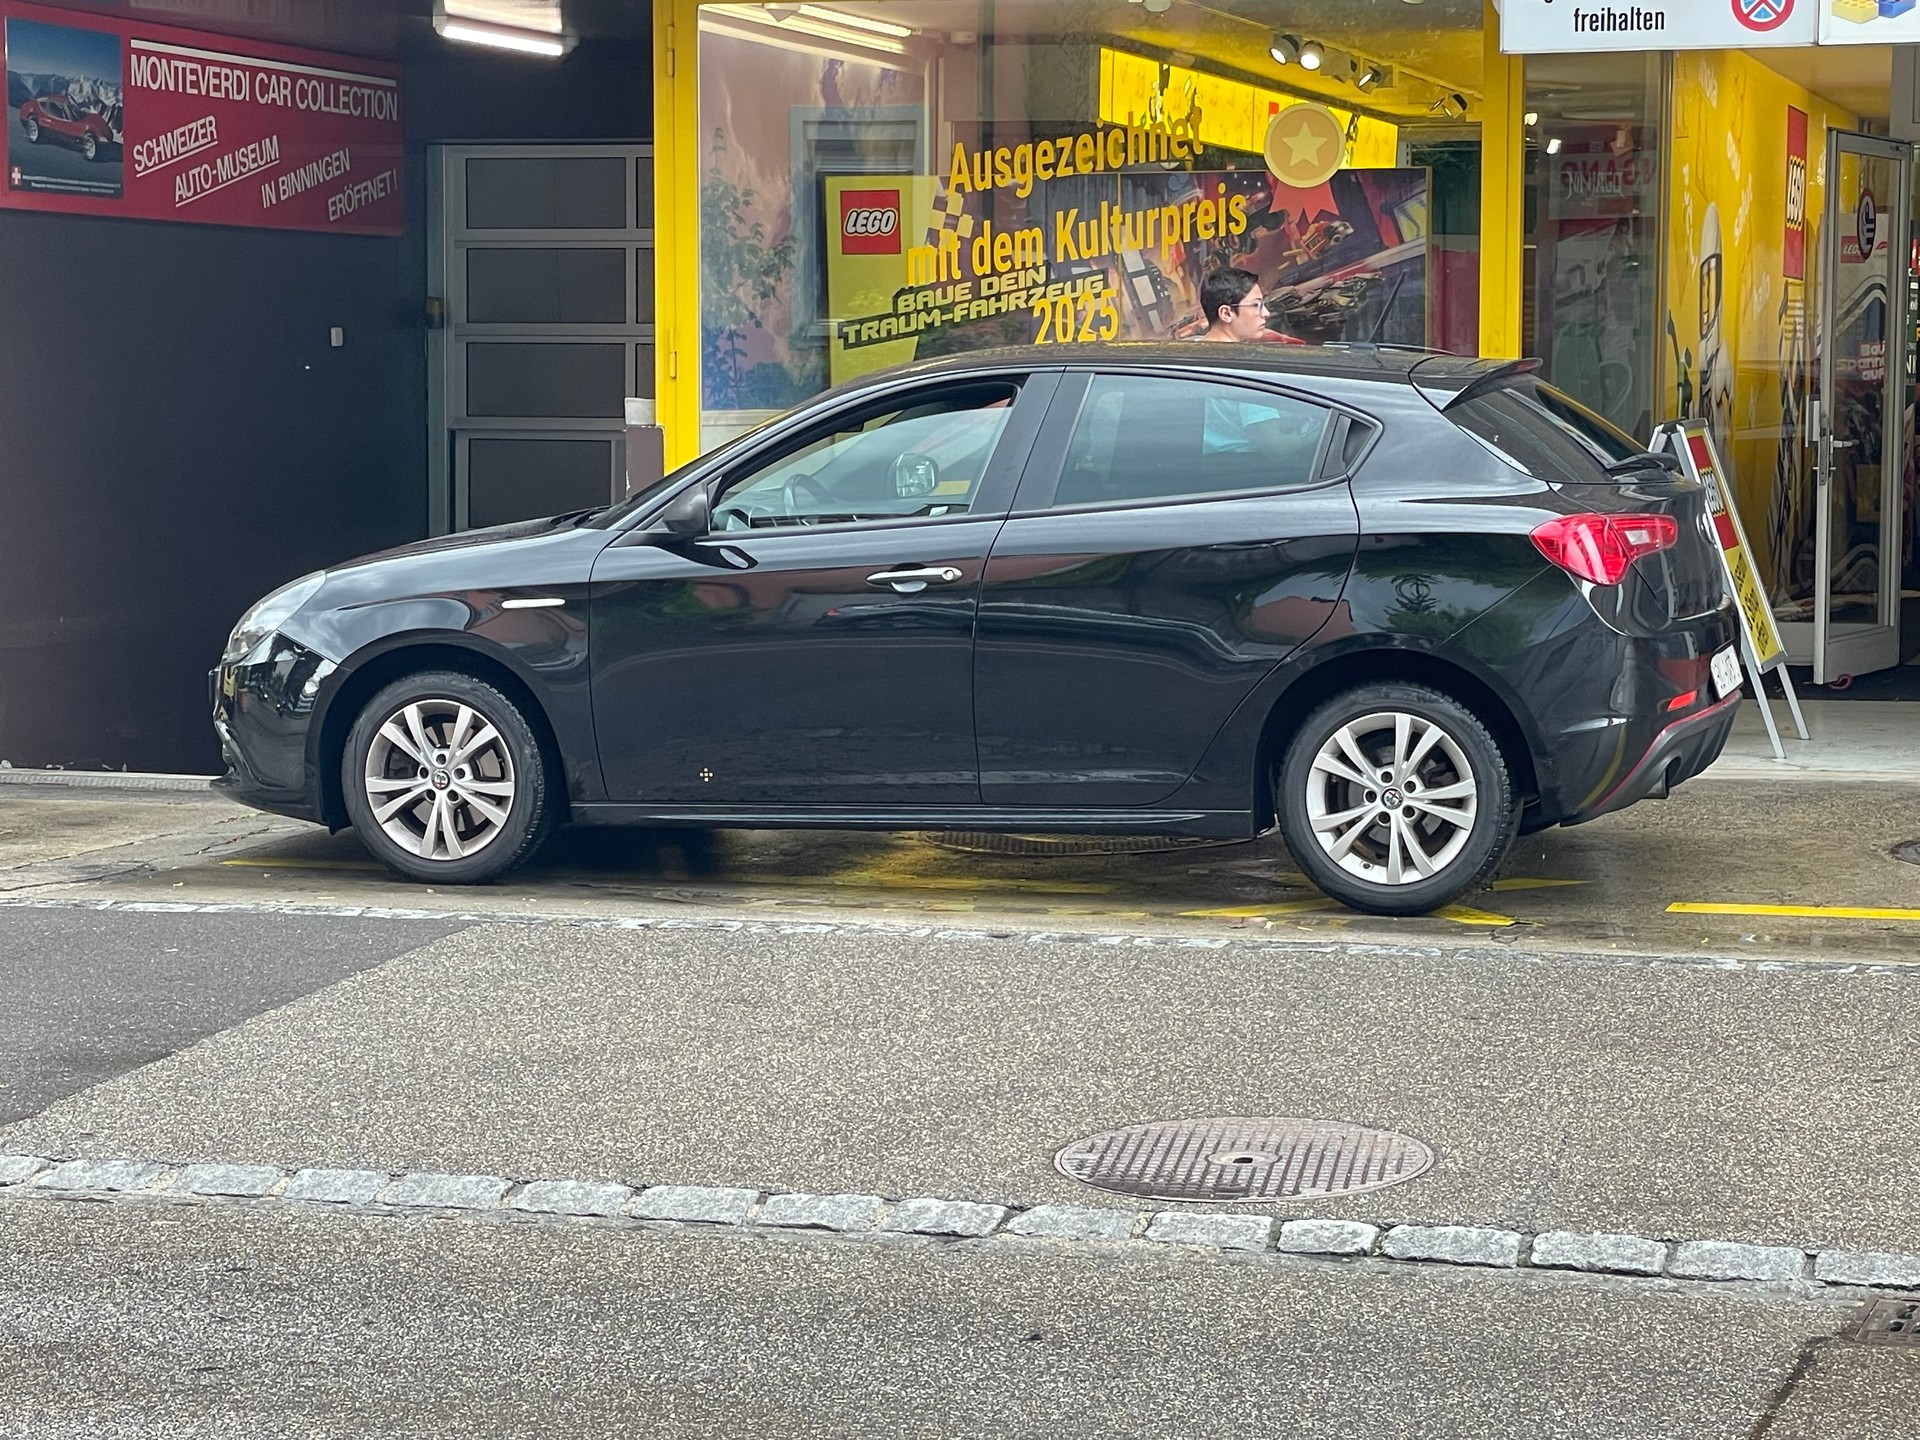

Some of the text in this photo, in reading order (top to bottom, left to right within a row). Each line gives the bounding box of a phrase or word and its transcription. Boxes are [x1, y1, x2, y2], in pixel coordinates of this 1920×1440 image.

[1573, 7, 1665, 32] freihalten
[130, 54, 398, 121] MONTEVERDI CAR COLLECTION
[133, 115, 218, 173] SCHWEIZER
[175, 134, 280, 203] AUTO-MUSEUM
[947, 106, 1204, 199] Ausgezeichnet
[261, 147, 351, 209] IN BINNINGEN
[845, 208, 898, 236] LEGO
[907, 182, 1248, 287] mit dem Kulturpreis
[842, 274, 1105, 344] TRAUM-FAHRZEUG
[897, 265, 1047, 314] BAUE DEIN
[1033, 287, 1120, 345] 2025
